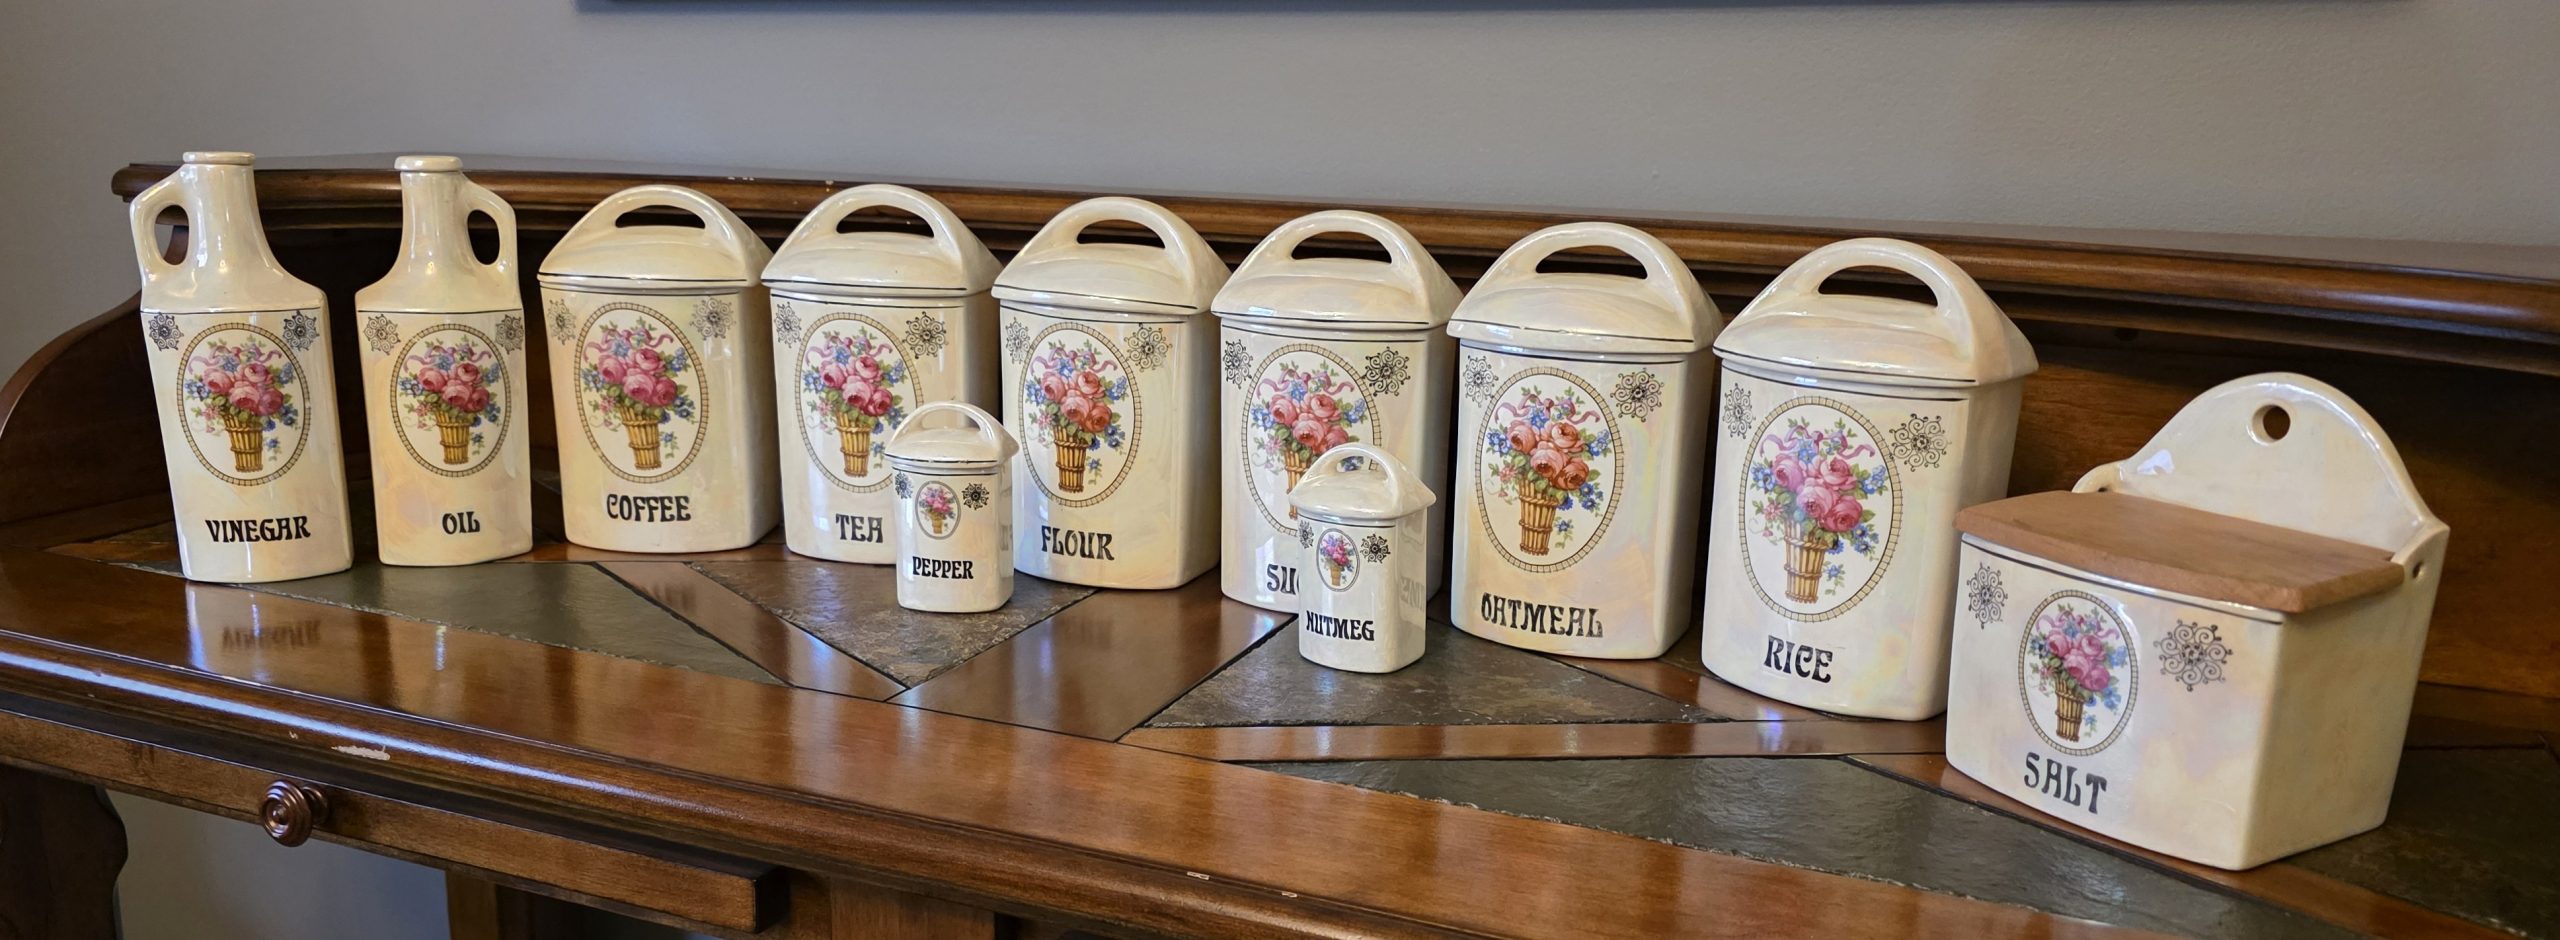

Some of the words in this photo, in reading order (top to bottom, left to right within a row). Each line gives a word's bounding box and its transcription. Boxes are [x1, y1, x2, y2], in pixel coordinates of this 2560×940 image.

[441, 510, 481, 535] OIL
[606, 493, 691, 522] COFFEE
[205, 515, 311, 543] VINEGAR
[835, 513, 884, 543] TEA
[1041, 525, 1115, 561] FLOUR
[912, 556, 974, 579] PEPPER
[1266, 563, 1299, 595] SU
[1306, 610, 1375, 641] NUTMEG
[1481, 591, 1604, 638] OATMEAL
[1763, 634, 1834, 684] RICE
[2024, 751, 2108, 815] SALT
